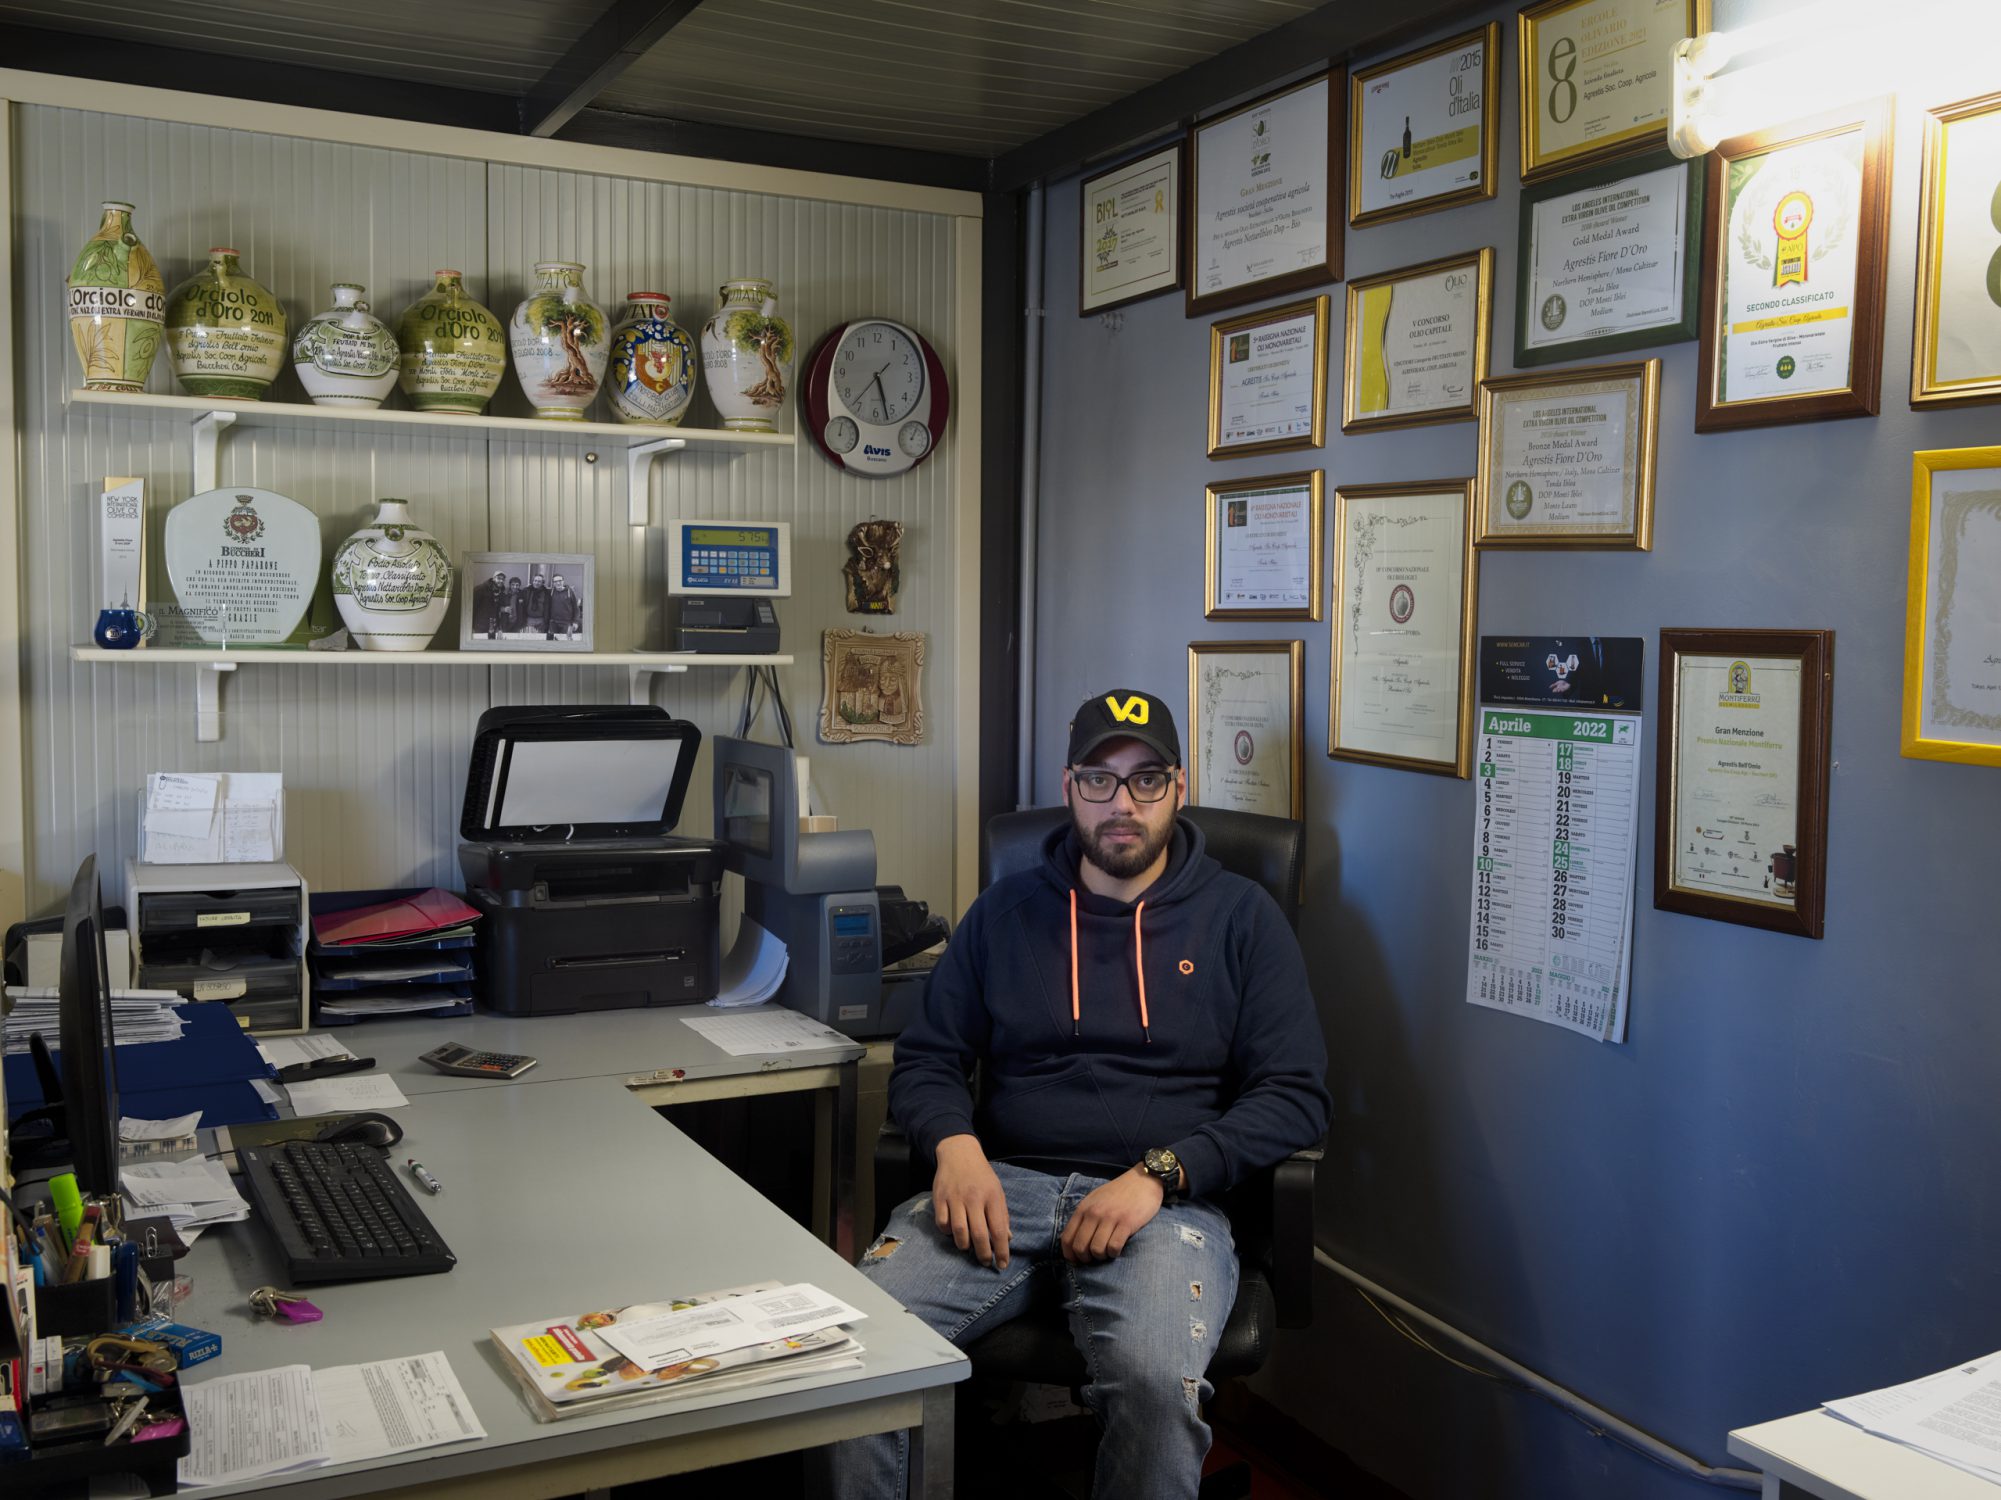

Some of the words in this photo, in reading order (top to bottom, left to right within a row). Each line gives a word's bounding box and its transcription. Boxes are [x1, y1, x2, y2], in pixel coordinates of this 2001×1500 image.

[1581, 8, 1617, 28] ERCOLE
[1581, 20, 1627, 43] OLIVARIO
[1582, 35, 1626, 58] EDIZIONE
[1629, 27, 1646, 41] 2021
[1461, 50, 1481, 71] 2015
[1635, 70, 1657, 84] Agricola
[1449, 76, 1463, 96] Oli
[1449, 93, 1480, 117] d'Italia
[1572, 202, 1581, 212] LOS
[1582, 197, 1601, 209] ANGELES
[1603, 188, 1639, 205] INTERNATIONAL
[1096, 197, 1119, 223] BIOL
[1562, 214, 1577, 224] EXTRA
[1579, 210, 1593, 220] VIRGIN
[1595, 205, 1608, 216] OLIVE
[1617, 195, 1650, 209] COMPETITION
[1573, 236, 1590, 247] Gold
[1592, 230, 1613, 242] Medal
[1616, 224, 1639, 236] Award
[1563, 254, 1596, 272] Agrestis
[1598, 250, 1618, 263] Fiore
[1620, 244, 1648, 258] D'Oro
[1552, 277, 1577, 288] Northern
[1578, 270, 1609, 282] Hemisphere
[1633, 261, 1658, 271] Cultivar
[1587, 285, 1604, 295] Tonda
[1579, 298, 1594, 308] DOP
[1746, 301, 1780, 312] SECONDO
[1782, 291, 1834, 307] CLASSIFICATO
[102, 307, 121, 315] EXTRA
[196, 302, 243, 321] d'Oro
[251, 309, 273, 325] 2011
[1591, 307, 1613, 317] Medium
[1418, 314, 1450, 326] CONCORSO
[435, 322, 480, 339] d'Oro
[1280, 326, 1306, 337] NAZIONALE
[1409, 330, 1423, 339] OLIO
[1425, 324, 1452, 336] CAPITALE
[857, 338, 865, 347] 11
[873, 333, 882, 343] 12
[892, 340, 895, 351] 1
[845, 351, 854, 360] 10
[903, 355, 909, 365] 2
[840, 368, 845, 377] 9
[907, 372, 912, 383] 3
[844, 388, 850, 397] 8
[902, 392, 907, 402] 4
[857, 403, 862, 411] 7
[873, 408, 879, 417] 6
[890, 404, 895, 414] 5
[1533, 410, 1541, 418] LOS
[1562, 406, 1596, 415] INTERNATIONAL
[1523, 419, 1538, 428] EXTRA
[1555, 417, 1567, 425] OLIVE
[1576, 414, 1606, 423] COMPETITION
[1529, 442, 1550, 450] Bronze
[1553, 440, 1573, 448] Medal
[1575, 438, 1598, 447] Award
[1522, 455, 1553, 468] Agrestis
[1555, 453, 1574, 464] Fiore
[1576, 451, 1602, 462] D'Oro
[738, 532, 761, 541] 575
[209, 560, 212, 568] A
[217, 560, 237, 568] PIPPO
[242, 561, 278, 570] PAPARONE
[368, 557, 390, 567] Podio
[382, 570, 425, 584] Classificato
[360, 593, 383, 606] Agrestis
[169, 606, 218, 615] MAGNIFICO
[228, 614, 257, 622] GRAZIE
[1719, 694, 1760, 703] MONTIFERRU
[1488, 717, 1532, 734] Aprile
[1573, 721, 1607, 737] 2022
[1715, 726, 1730, 735] Gran
[1732, 728, 1764, 737] Menzione
[1487, 738, 1491, 749] 1
[1719, 738, 1747, 747] Nazionale
[1559, 744, 1572, 755] 17
[1485, 751, 1491, 762] 2
[1558, 758, 1571, 770] 18
[1484, 765, 1491, 776] 3
[1484, 778, 1491, 789] 4
[1558, 772, 1571, 784] 19
[1485, 792, 1491, 802] 5
[1557, 786, 1570, 798] 20
[1484, 805, 1491, 816] 6
[1557, 800, 1569, 812] 21
[1484, 818, 1490, 829] 7
[1556, 814, 1569, 826] 22
[1483, 832, 1489, 842] 8
[1556, 828, 1569, 840] 23
[1483, 845, 1489, 856] 9
[1555, 842, 1568, 854] 24
[1479, 859, 1491, 870] 10
[1554, 856, 1568, 868] 25
[1479, 872, 1490, 883] 11
[1554, 870, 1567, 882] 26
[1478, 885, 1490, 897] 12
[1554, 884, 1566, 896] 27
[1478, 898, 1490, 910] 13
[1553, 898, 1566, 911] 28
[1477, 912, 1489, 924] 14
[1552, 912, 1565, 924] 29
[1476, 925, 1489, 937] 15
[1552, 926, 1565, 938] 30
[1476, 938, 1488, 950] 16
